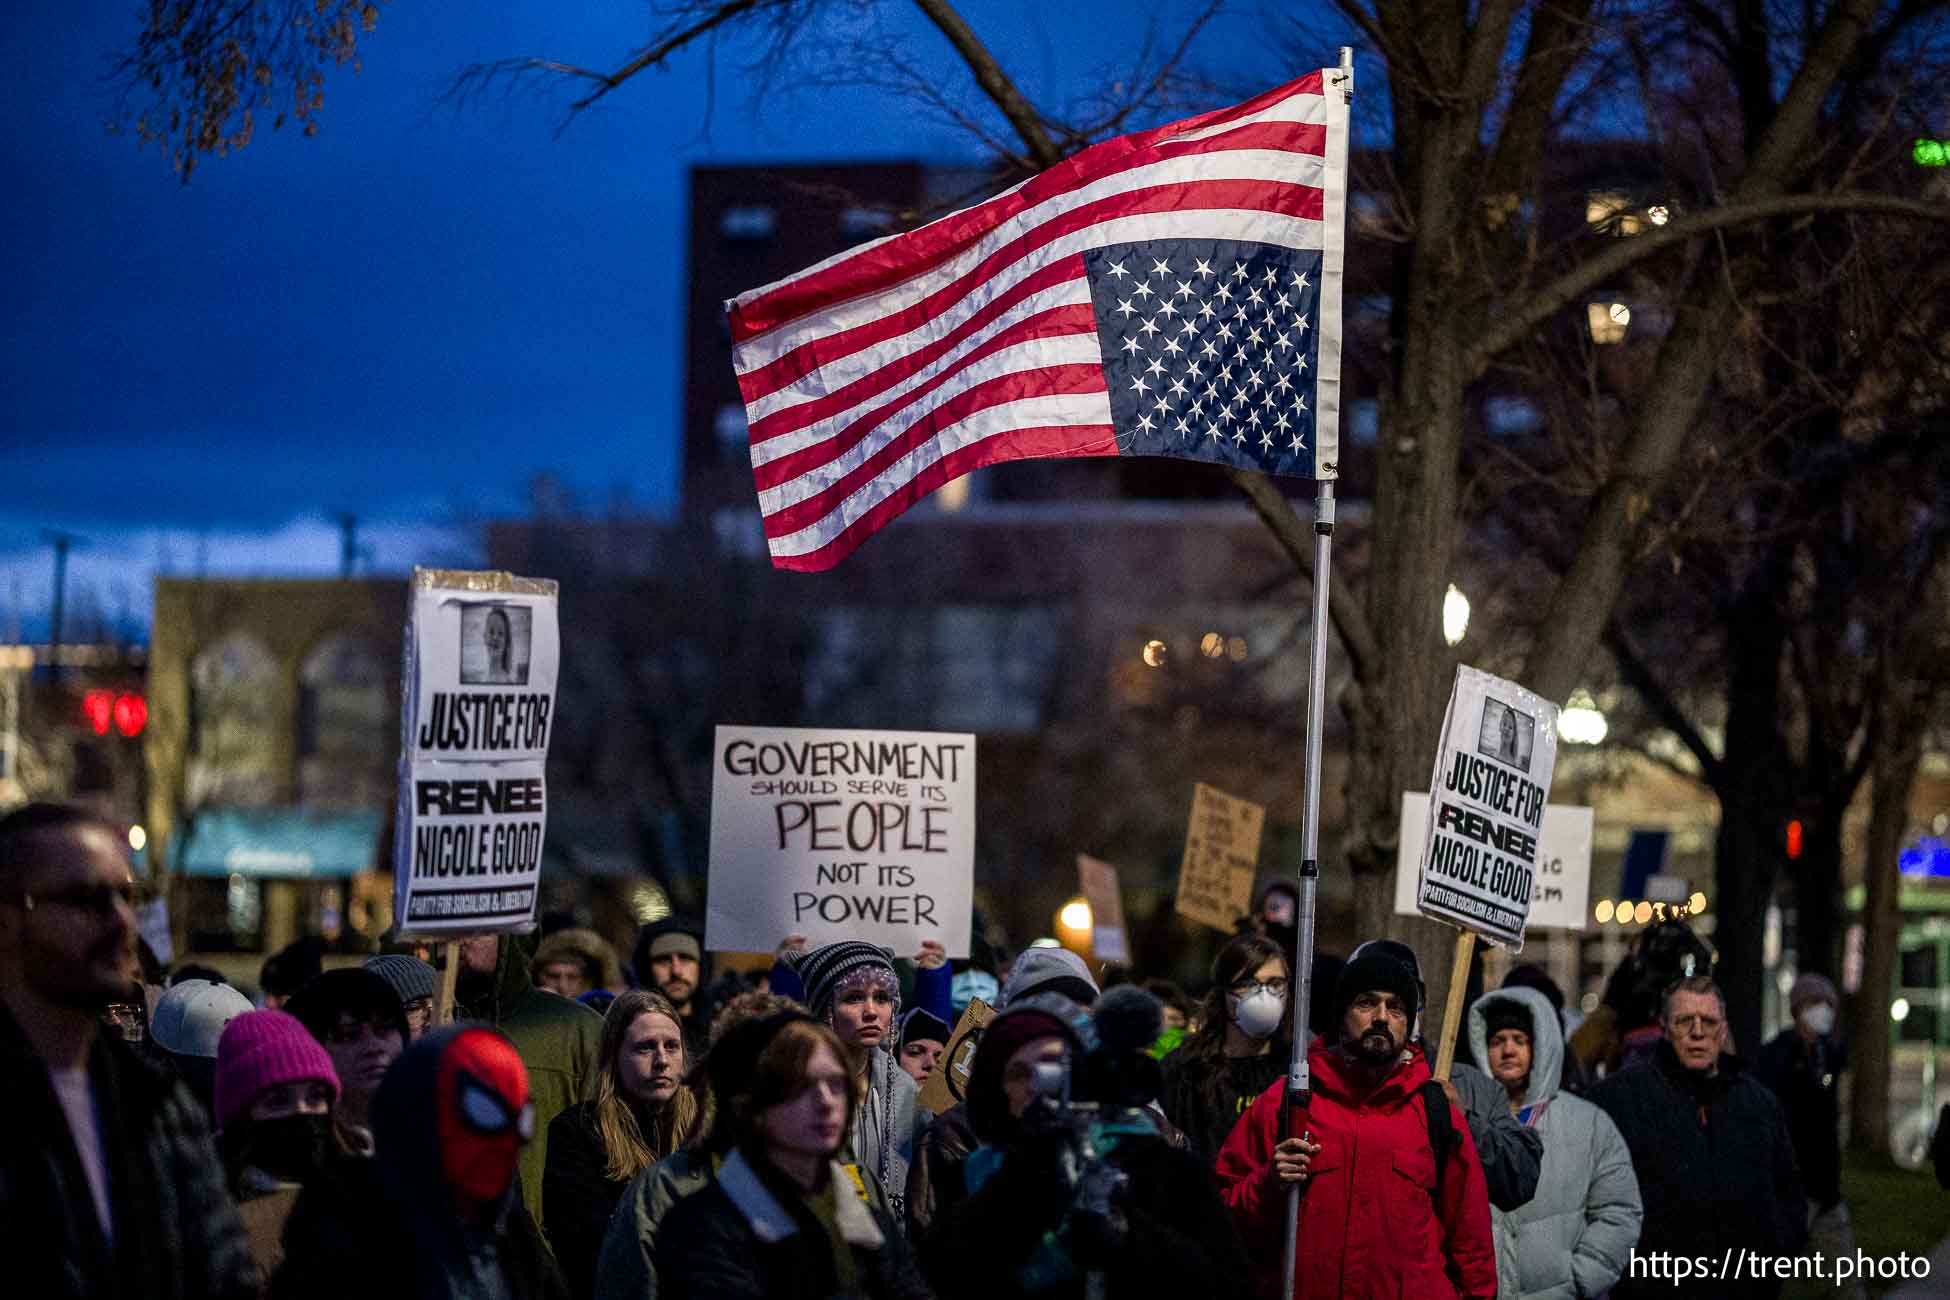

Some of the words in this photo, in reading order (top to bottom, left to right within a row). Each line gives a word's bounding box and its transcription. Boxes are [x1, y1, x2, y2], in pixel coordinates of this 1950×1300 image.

[419, 692, 515, 750] JUSTICE
[514, 694, 550, 749] FOR
[724, 741, 964, 782] GOVERNMENT
[416, 778, 543, 816] RENEE
[750, 780, 838, 795] SHOULD
[848, 780, 908, 798] SERVE
[920, 784, 947, 801] ITS
[1446, 751, 1517, 815] JUSTICE
[1514, 778, 1545, 828] FOR
[414, 823, 490, 878] NICOLE
[491, 821, 541, 875] GOOD
[775, 800, 948, 853] PEOPLE
[1438, 802, 1536, 864] RENEE
[816, 863, 868, 886] NOT
[878, 865, 915, 887] ITS
[1429, 834, 1492, 889] NICOLE
[1490, 856, 1532, 905] GOOD
[793, 893, 938, 926] POWER
[1486, 907, 1494, 920] &
